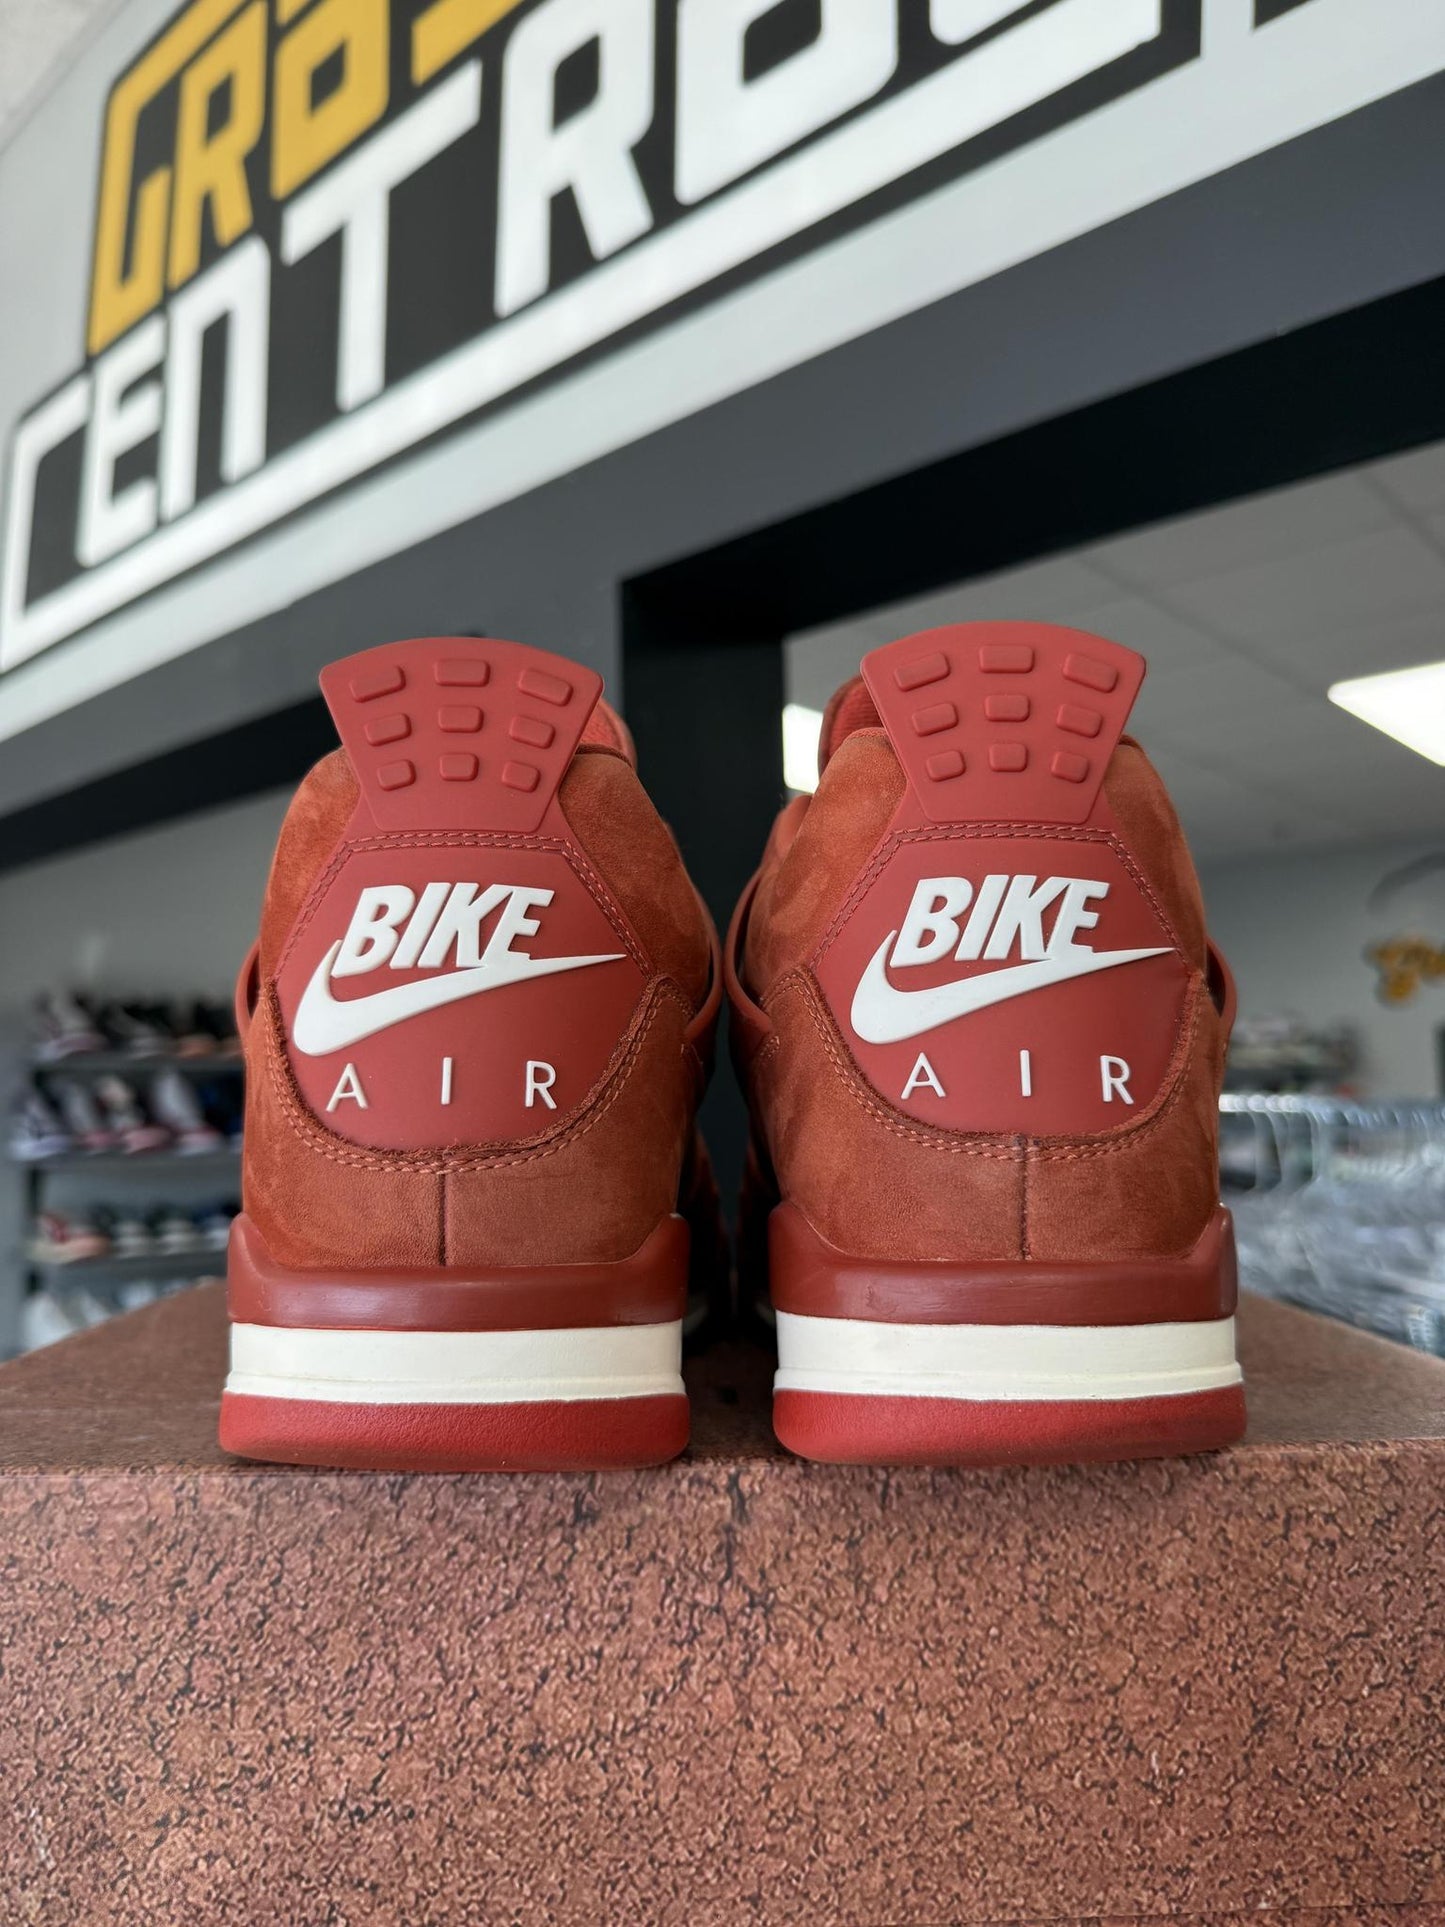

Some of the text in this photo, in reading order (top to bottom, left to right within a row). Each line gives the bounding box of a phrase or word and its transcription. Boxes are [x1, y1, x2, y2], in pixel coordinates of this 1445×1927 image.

[0, 0, 1040, 672] CENTR
[331, 881, 555, 978] BIKE
[890, 874, 1110, 968] BIKE
[326, 1056, 557, 1113] AIR
[901, 1050, 1134, 1105] AIR
